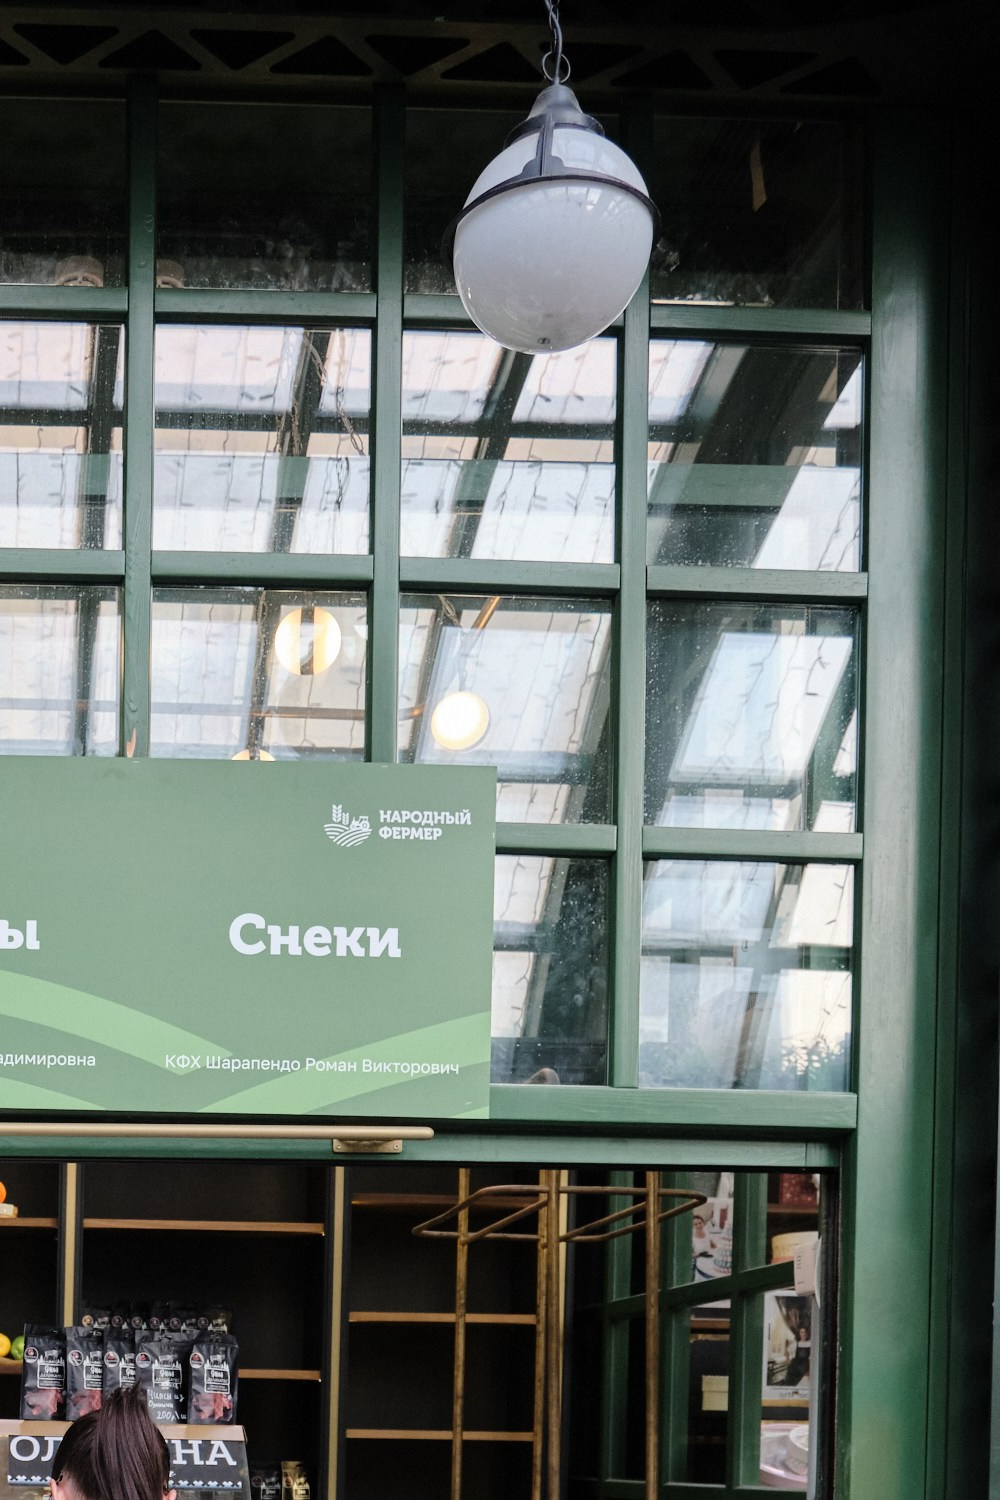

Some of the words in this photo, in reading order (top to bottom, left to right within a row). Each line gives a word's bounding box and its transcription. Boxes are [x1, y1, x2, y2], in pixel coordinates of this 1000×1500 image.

[379, 808, 472, 826] НАРОДНЫЙ
[378, 825, 443, 841] ФЕРМЕР
[228, 912, 402, 958] Снеки
[165, 1053, 201, 1070] КФХ
[205, 1055, 301, 1072] Шарапендо
[304, 1057, 358, 1073] Роман
[361, 1058, 460, 1077] Викторович
